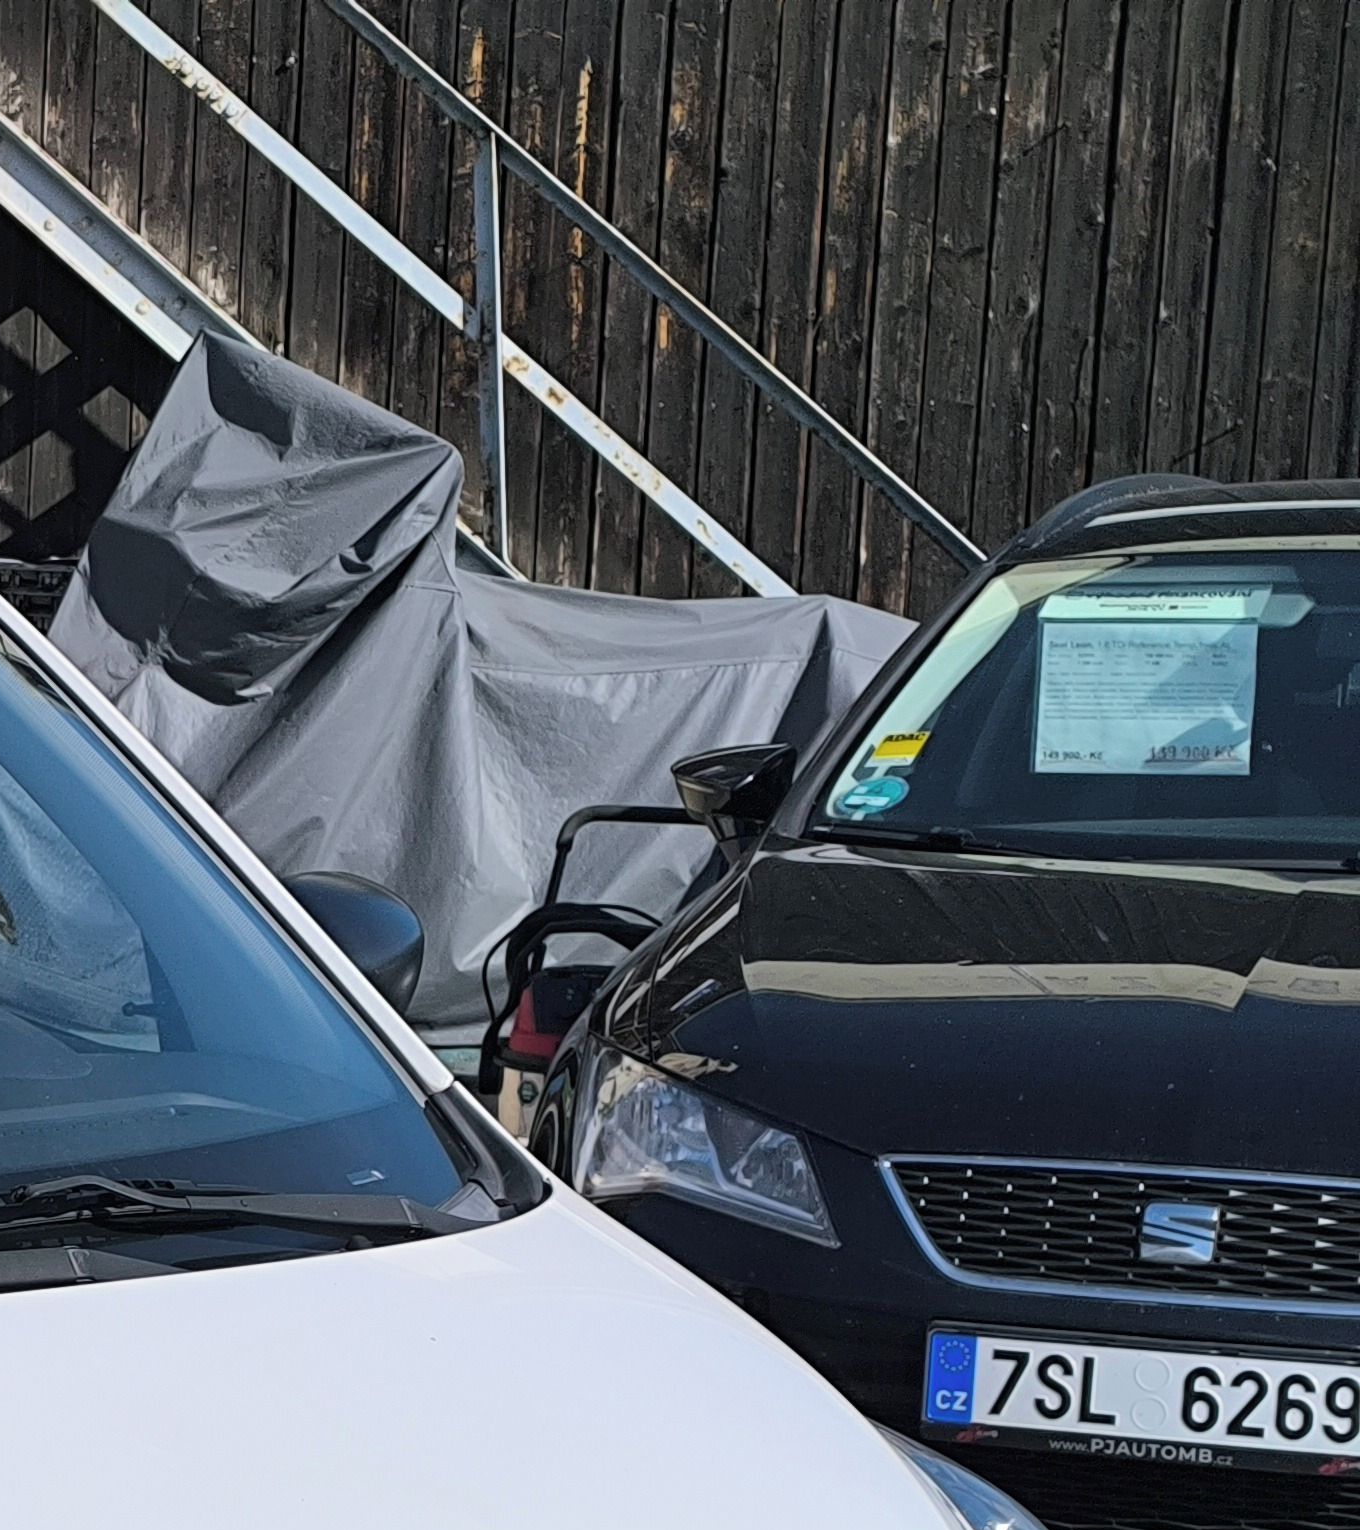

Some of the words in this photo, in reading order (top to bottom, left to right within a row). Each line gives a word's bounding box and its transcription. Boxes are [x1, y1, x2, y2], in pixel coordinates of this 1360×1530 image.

[935, 1389, 968, 1412] CZ
[988, 1348, 1117, 1425] 7SL
[1182, 1366, 1360, 1443] 6269
[1048, 1437, 1234, 1466] www.PJAUTOMB.cz
